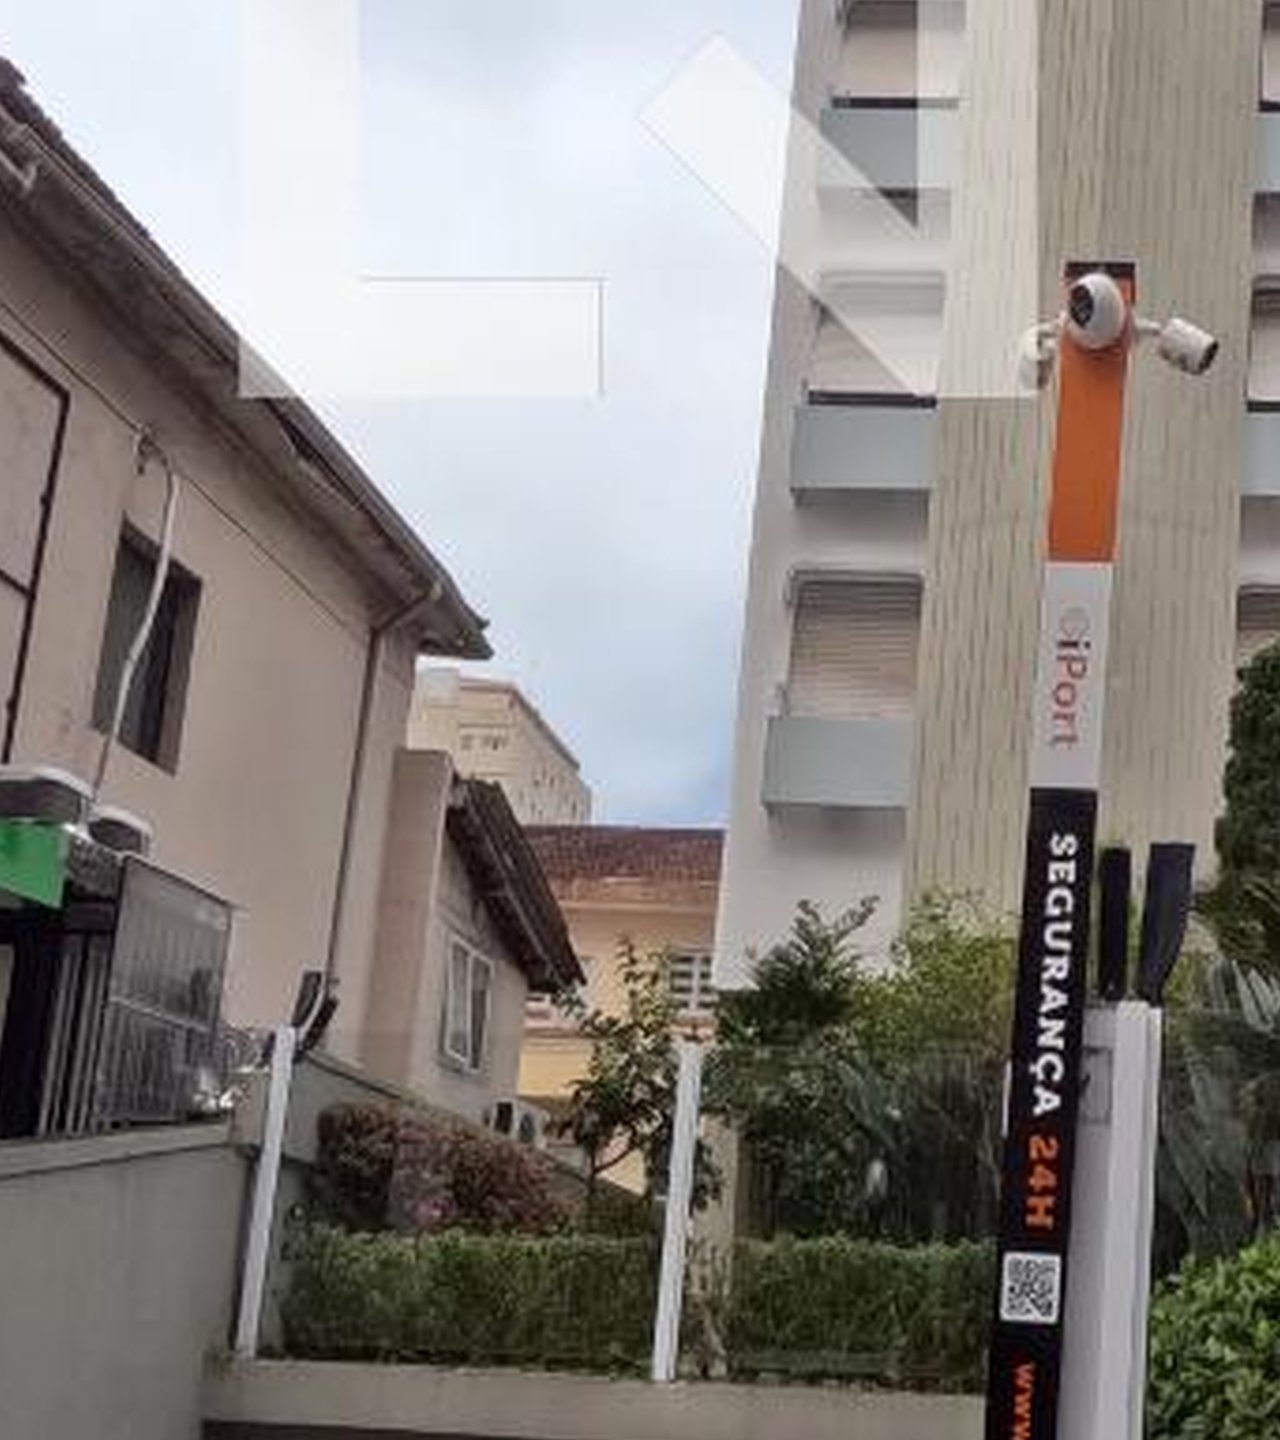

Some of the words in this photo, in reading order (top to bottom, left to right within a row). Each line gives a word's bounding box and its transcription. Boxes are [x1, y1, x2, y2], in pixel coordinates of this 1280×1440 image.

[1050, 638, 1091, 750] iPort
[1029, 833, 1077, 1117] SEGURANÇA
[1025, 1134, 1059, 1232] 24H
